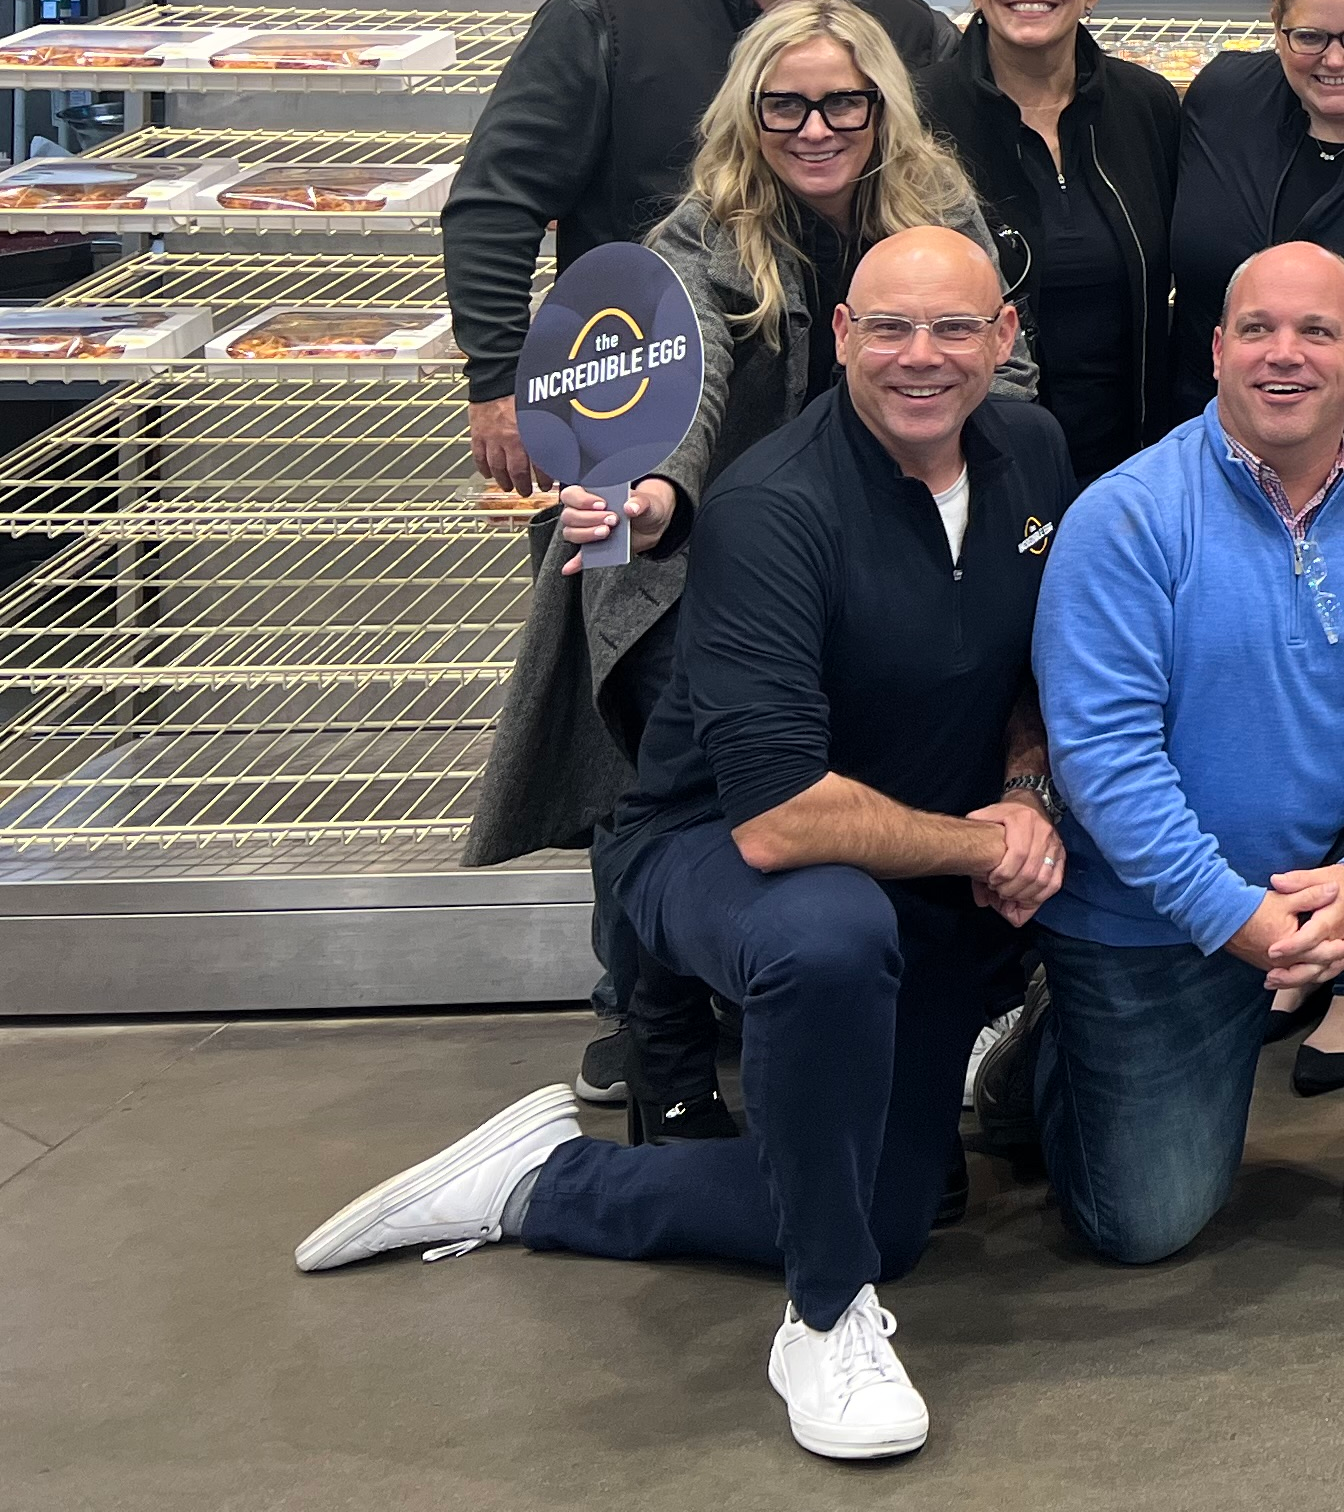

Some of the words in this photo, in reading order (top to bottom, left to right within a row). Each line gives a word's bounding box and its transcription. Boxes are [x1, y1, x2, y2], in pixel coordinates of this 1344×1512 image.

[595, 334, 619, 352] the
[528, 347, 644, 404] INCREDIBLE
[648, 335, 687, 369] EGG
